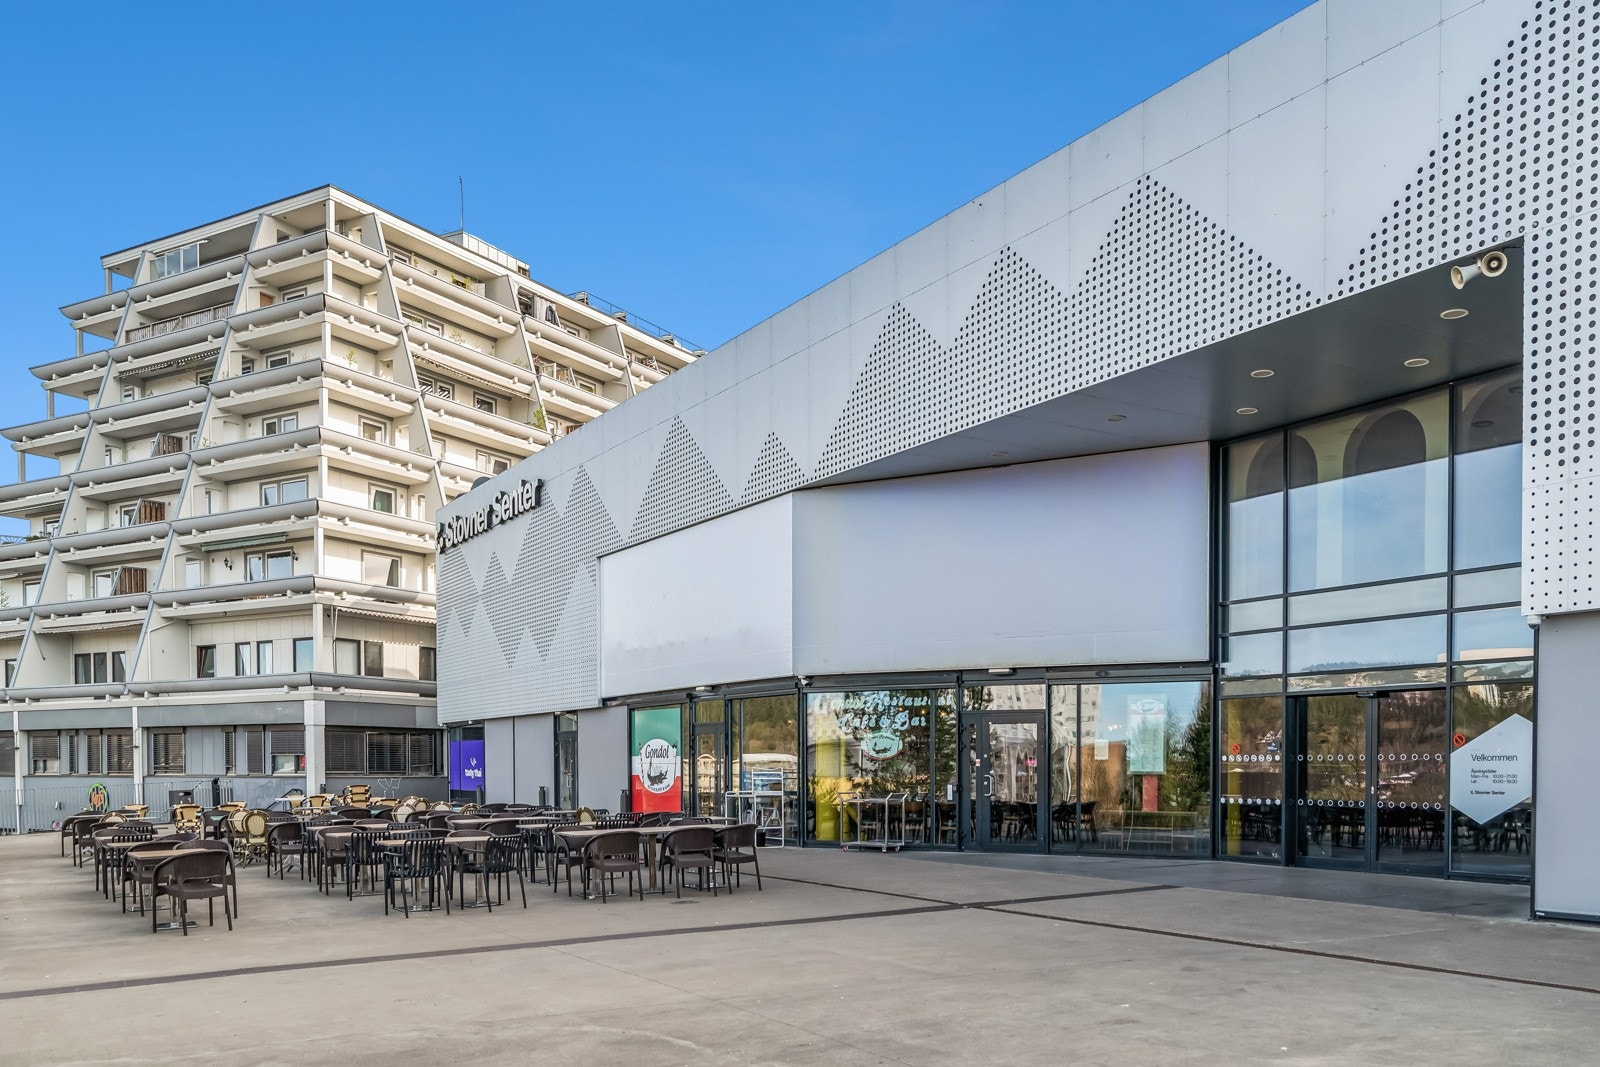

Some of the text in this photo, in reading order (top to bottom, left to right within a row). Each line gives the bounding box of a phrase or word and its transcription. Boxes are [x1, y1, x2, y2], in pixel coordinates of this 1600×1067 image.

[445, 479, 543, 547] Stovner Senter
[865, 690, 952, 711] Restaurnt
[645, 744, 669, 759] Gondol
[1471, 753, 1518, 762] Velkommen
